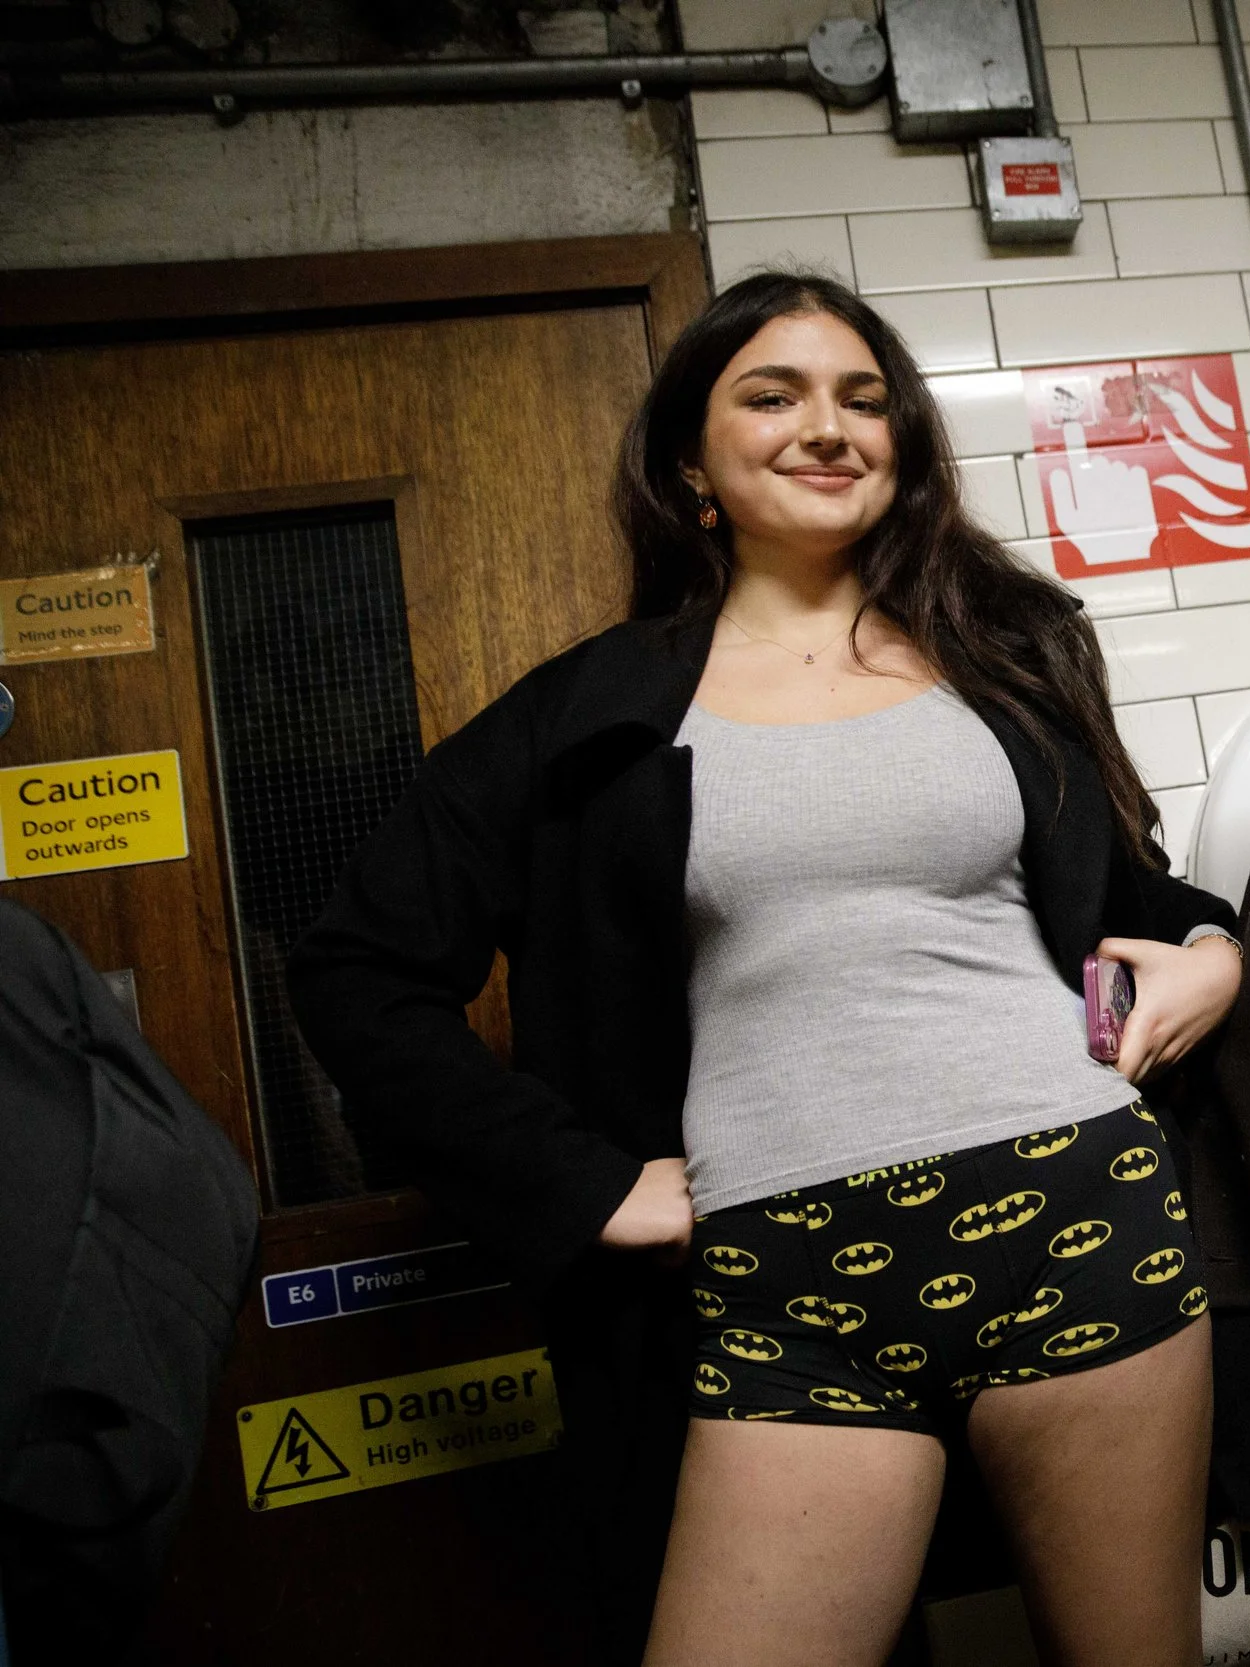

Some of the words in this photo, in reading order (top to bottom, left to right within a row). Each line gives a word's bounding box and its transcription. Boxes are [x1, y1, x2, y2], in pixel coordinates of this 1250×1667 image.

[15, 587, 133, 616] Caution
[18, 629, 56, 643] Mind
[60, 627, 86, 639] the
[90, 623, 122, 637] step
[19, 770, 161, 807] Caution
[22, 817, 76, 838] Door
[86, 809, 151, 831] opens
[26, 835, 128, 861] outwards
[288, 1284, 316, 1305] E6
[352, 1266, 427, 1294] Private
[360, 1369, 537, 1429] Danger
[367, 1438, 429, 1467] High
[437, 1419, 535, 1452] voltage
